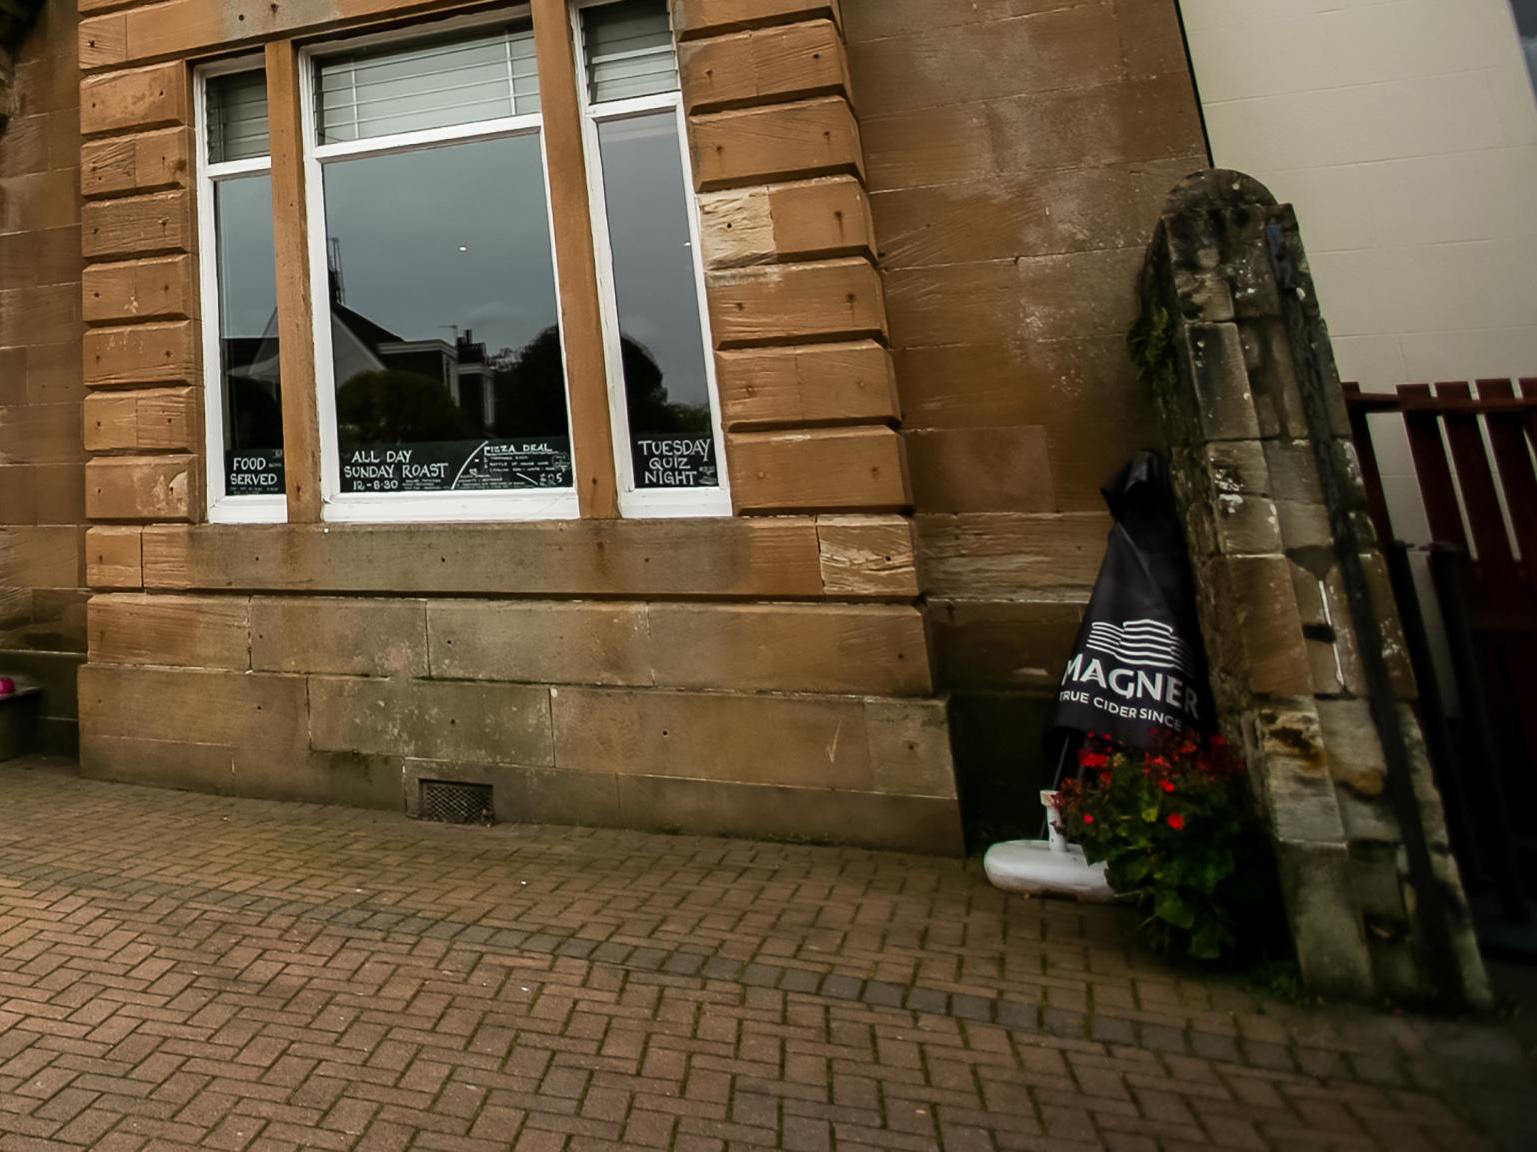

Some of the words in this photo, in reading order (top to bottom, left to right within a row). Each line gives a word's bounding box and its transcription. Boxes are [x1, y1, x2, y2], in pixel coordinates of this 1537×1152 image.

[523, 443, 553, 452] DEAL
[638, 439, 711, 461] TUESDAY
[233, 457, 266, 470] FOOD
[351, 450, 380, 463] ALL
[386, 450, 412, 463] DAY
[649, 456, 691, 471] QUIZ
[344, 464, 394, 478] SUNDAY
[402, 463, 448, 478] ROAST
[230, 473, 277, 485] SERVED
[645, 471, 697, 485] NIGHT
[1061, 653, 1198, 720] MAGNER
[1093, 697, 1137, 718] CIDER
[1139, 708, 1182, 732] SINCE
